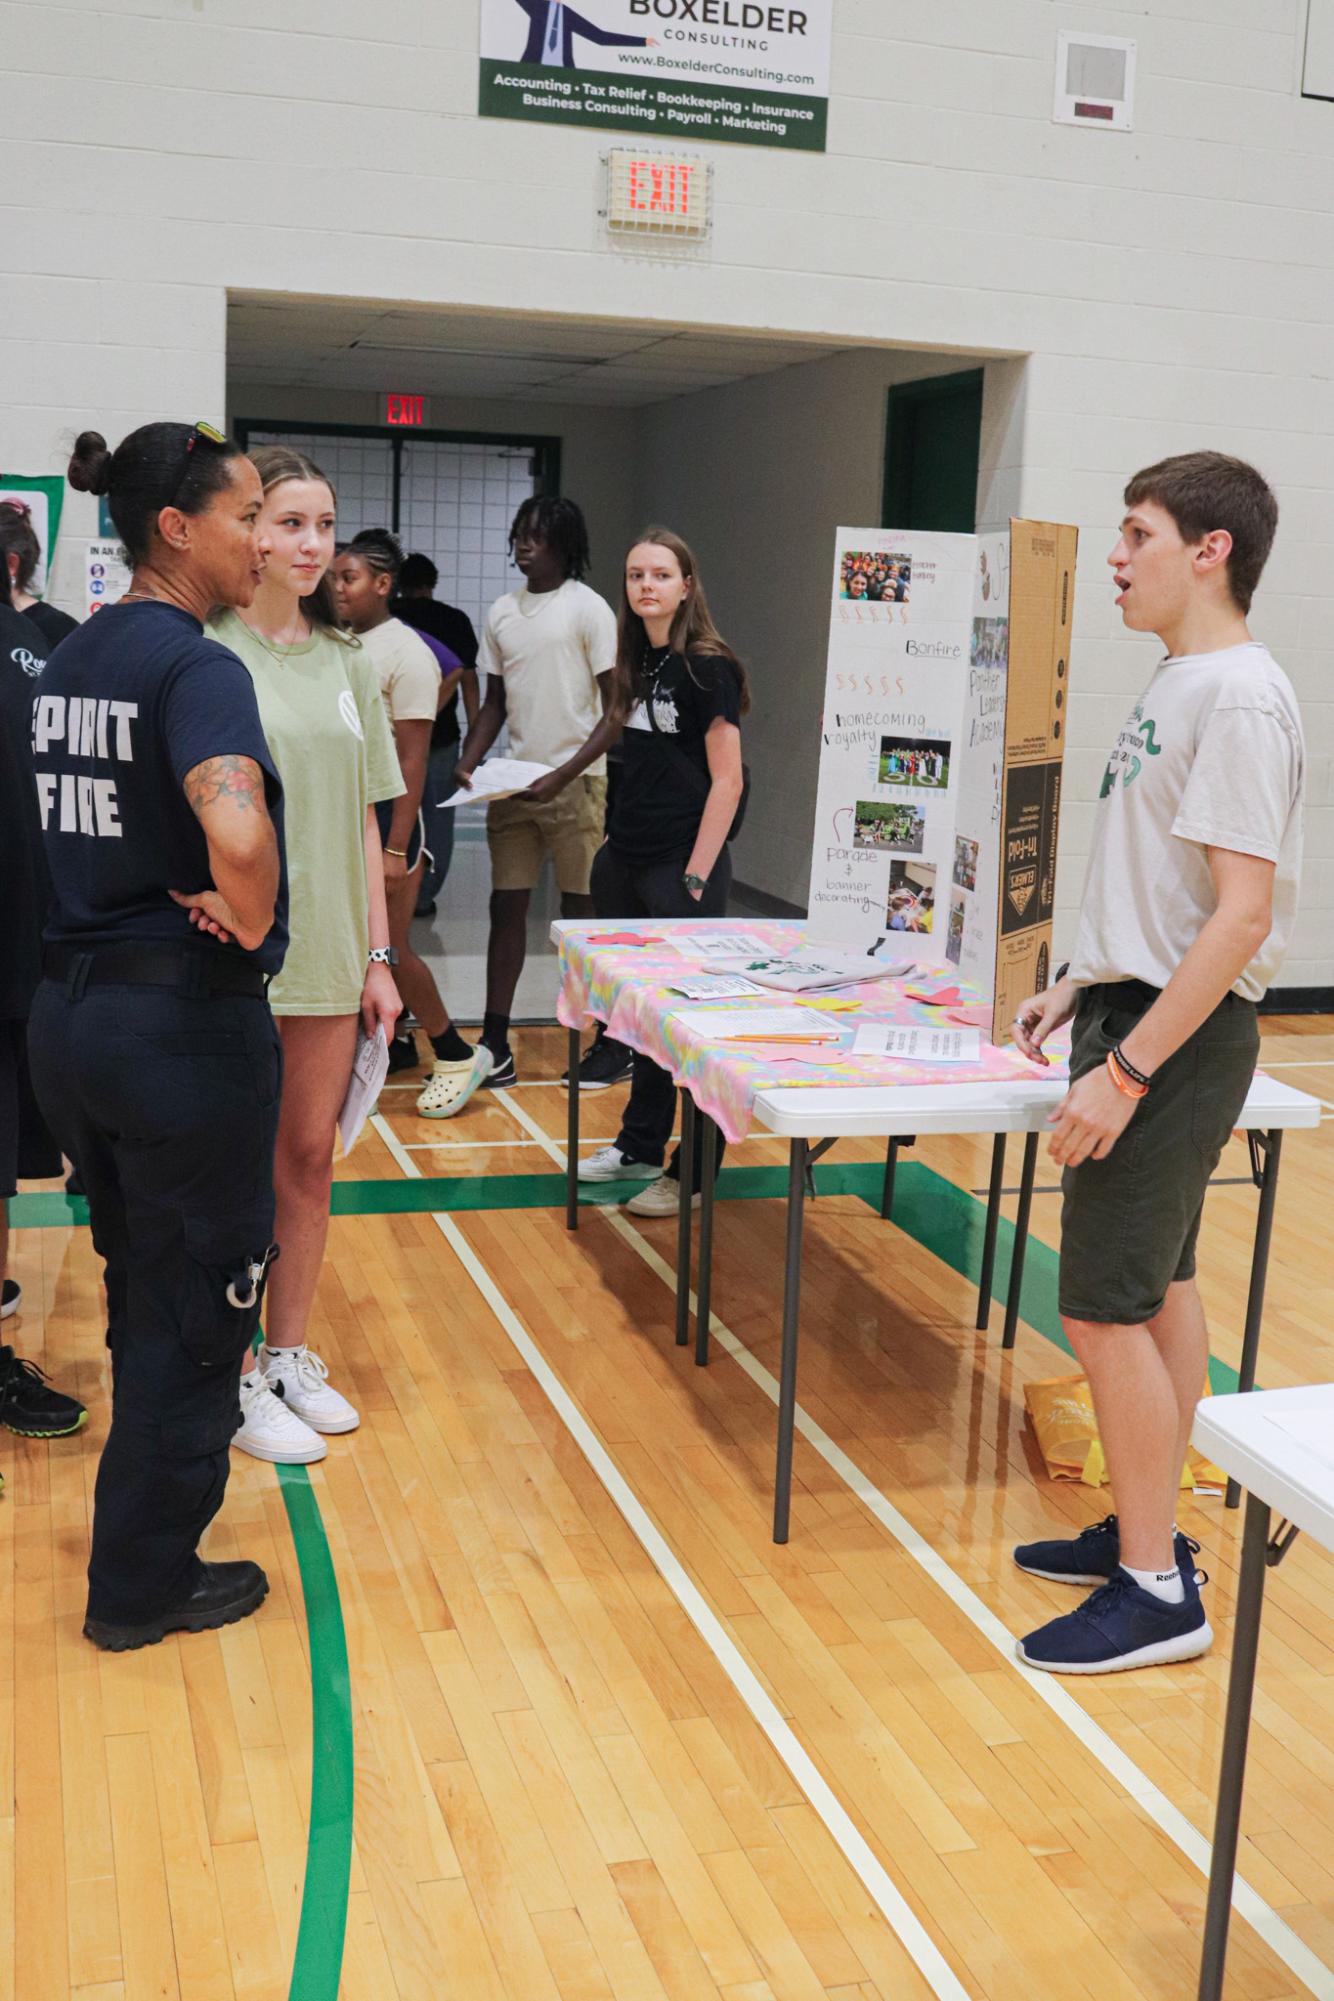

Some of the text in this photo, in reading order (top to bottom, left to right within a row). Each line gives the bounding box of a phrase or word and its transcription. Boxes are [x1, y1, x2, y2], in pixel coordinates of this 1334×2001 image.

[629, 0, 808, 36] BOXELDER
[663, 28, 769, 51] CONSULTING
[618, 52, 815, 85] www.BoxelderConsulting.com
[493, 73, 814, 120] Accounting Tax Relief Bookkeeping Insurance
[523, 93, 787, 136] Business Consulting Payroll Marketing
[629, 161, 694, 214] EXIT
[387, 393, 425, 426] EXIT
[90, 546, 100, 555] IN
[102, 547, 115, 556] AN
[906, 639, 961, 658] Bonfire
[31, 695, 138, 762] PIRIT
[824, 730, 877, 752] royalty
[35, 773, 122, 837] FIRE
[827, 847, 878, 862] parade
[826, 877, 872, 891] banner
[814, 889, 871, 913] decorating
